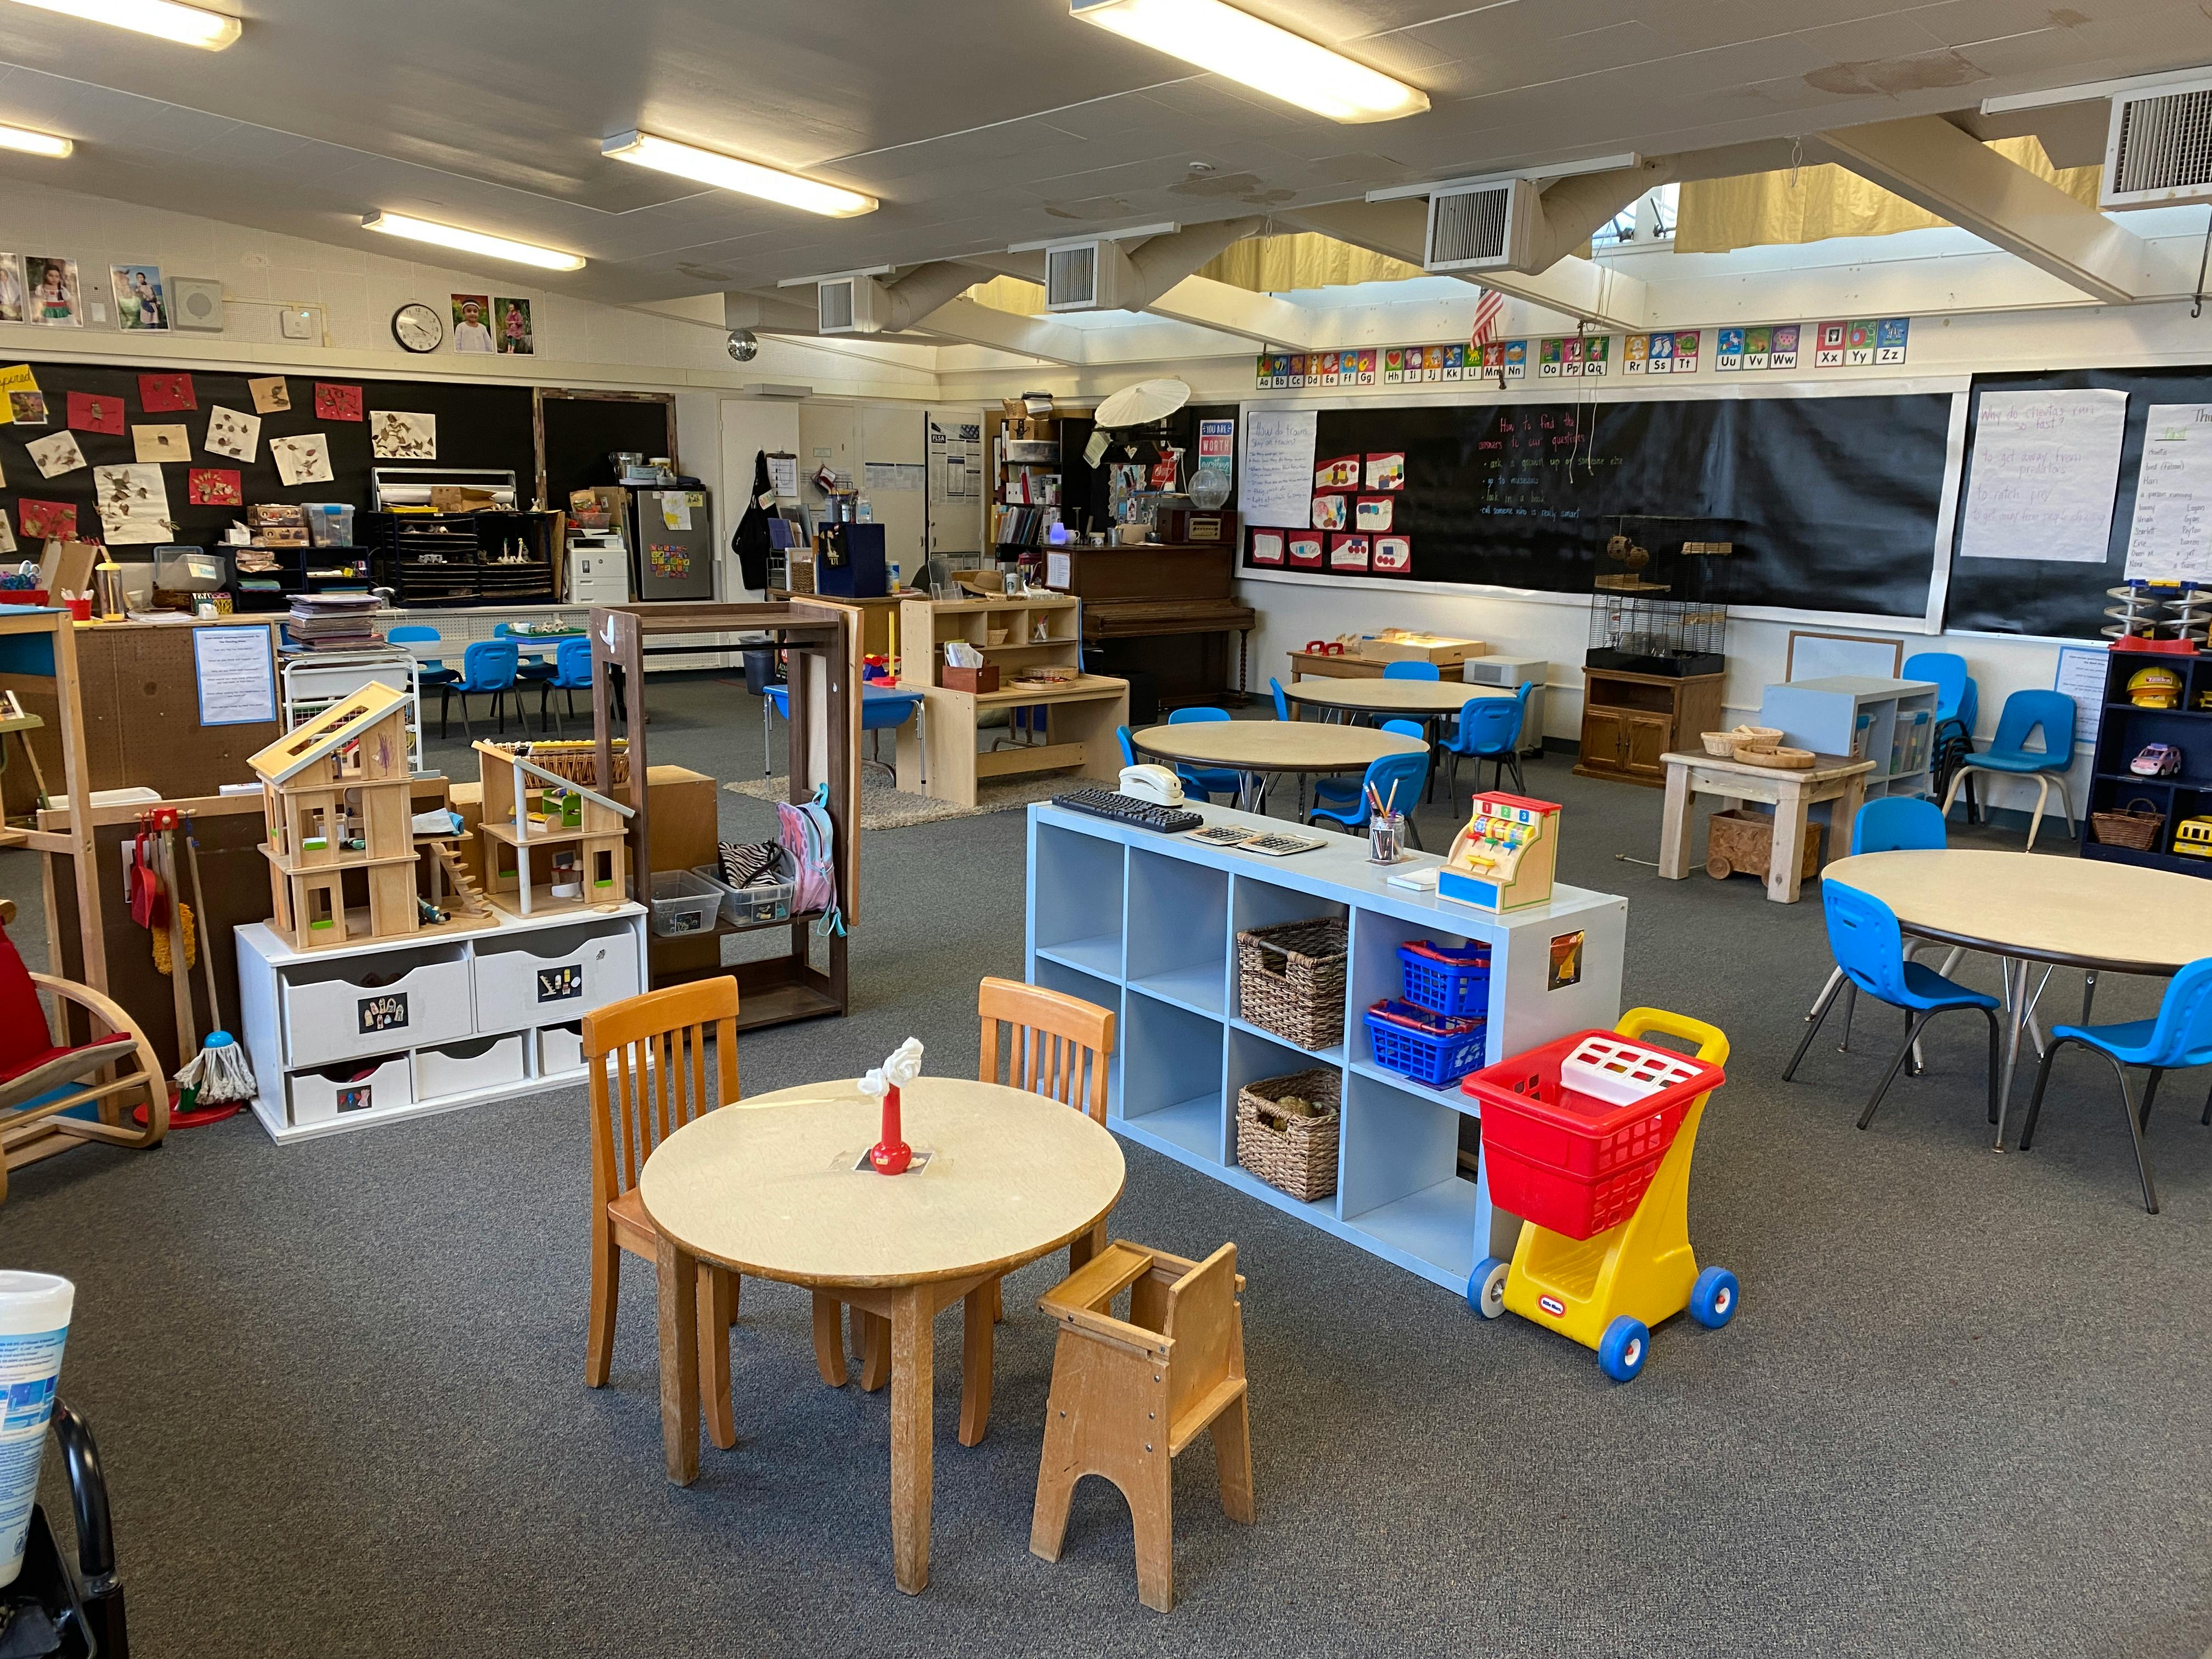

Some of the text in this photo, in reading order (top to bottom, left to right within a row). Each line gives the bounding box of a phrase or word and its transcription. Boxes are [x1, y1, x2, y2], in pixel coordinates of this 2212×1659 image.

[1722, 354, 1794, 366] Uu Vv Ww
[1821, 349, 1898, 364] Xx Yy Zz
[1544, 363, 1602, 375] Oo Pp Qq
[1630, 359, 1690, 371] Rr Ss Tt
[1292, 376, 1300, 385] Cc
[1308, 376, 1317, 384] Dd
[1361, 373, 1371, 383] Gg
[1388, 372, 1399, 380] Hh
[1409, 371, 1416, 379] Ii
[1428, 369, 1435, 380] Jj
[1447, 369, 1457, 377] Kk
[1469, 368, 1476, 376] Ll
[1508, 366, 1520, 375] Nn
[1981, 405, 2001, 426] Why
[2007, 406, 2018, 419] do
[1206, 424, 1227, 433] YOU ARE
[1256, 421, 1307, 437] How do trains
[1500, 413, 1575, 433] How to find the
[2015, 422, 2027, 431] so
[1203, 439, 1229, 452] WORTH
[1511, 435, 1519, 448] to
[1983, 445, 2081, 467] to get away from
[1550, 459, 1560, 472] up
[1498, 474, 1505, 484] to
[1487, 487, 1499, 501] look
[1531, 490, 1546, 504] book
[1977, 482, 1988, 500] to
[2030, 488, 2053, 505] prey
[1561, 506, 1581, 518] smart
